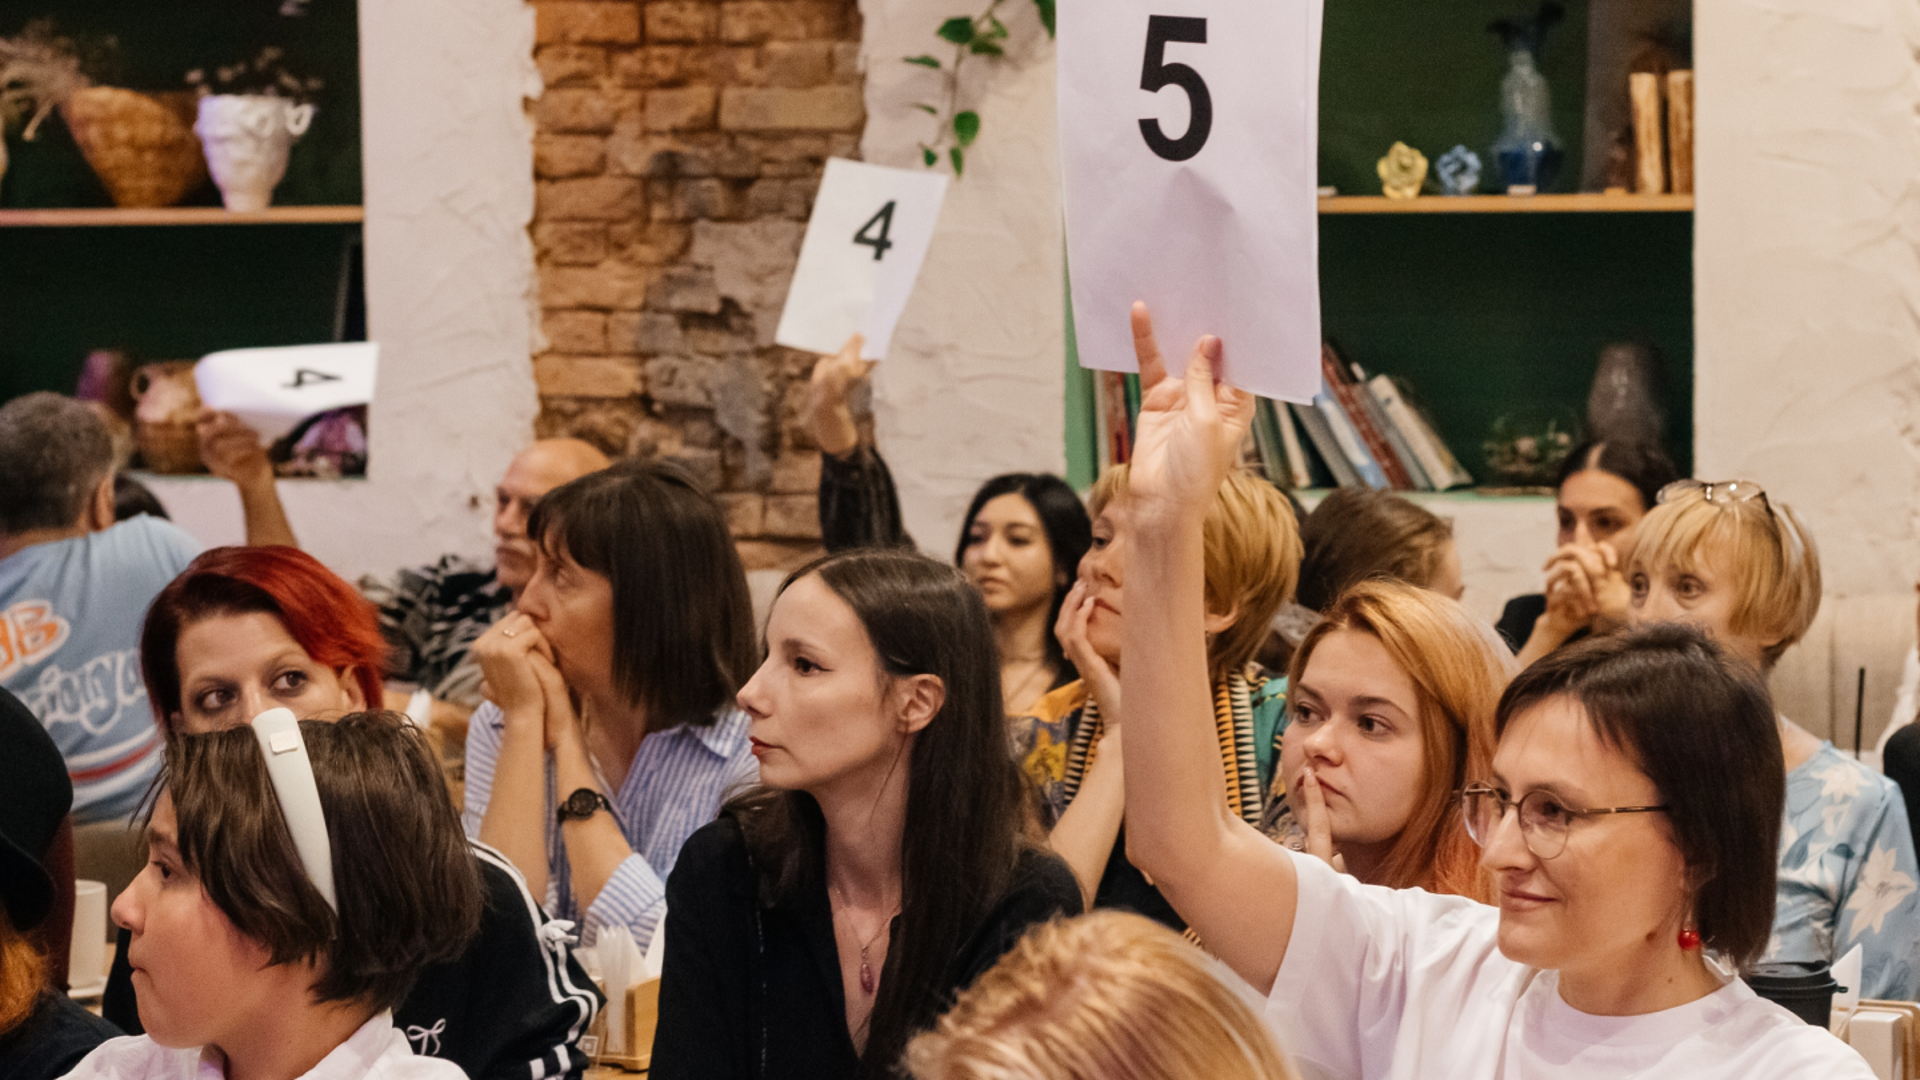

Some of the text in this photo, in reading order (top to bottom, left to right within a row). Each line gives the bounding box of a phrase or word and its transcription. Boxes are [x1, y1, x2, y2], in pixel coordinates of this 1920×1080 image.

[1138, 14, 1213, 162] 5
[853, 200, 896, 261] 4
[281, 368, 342, 389] 4
